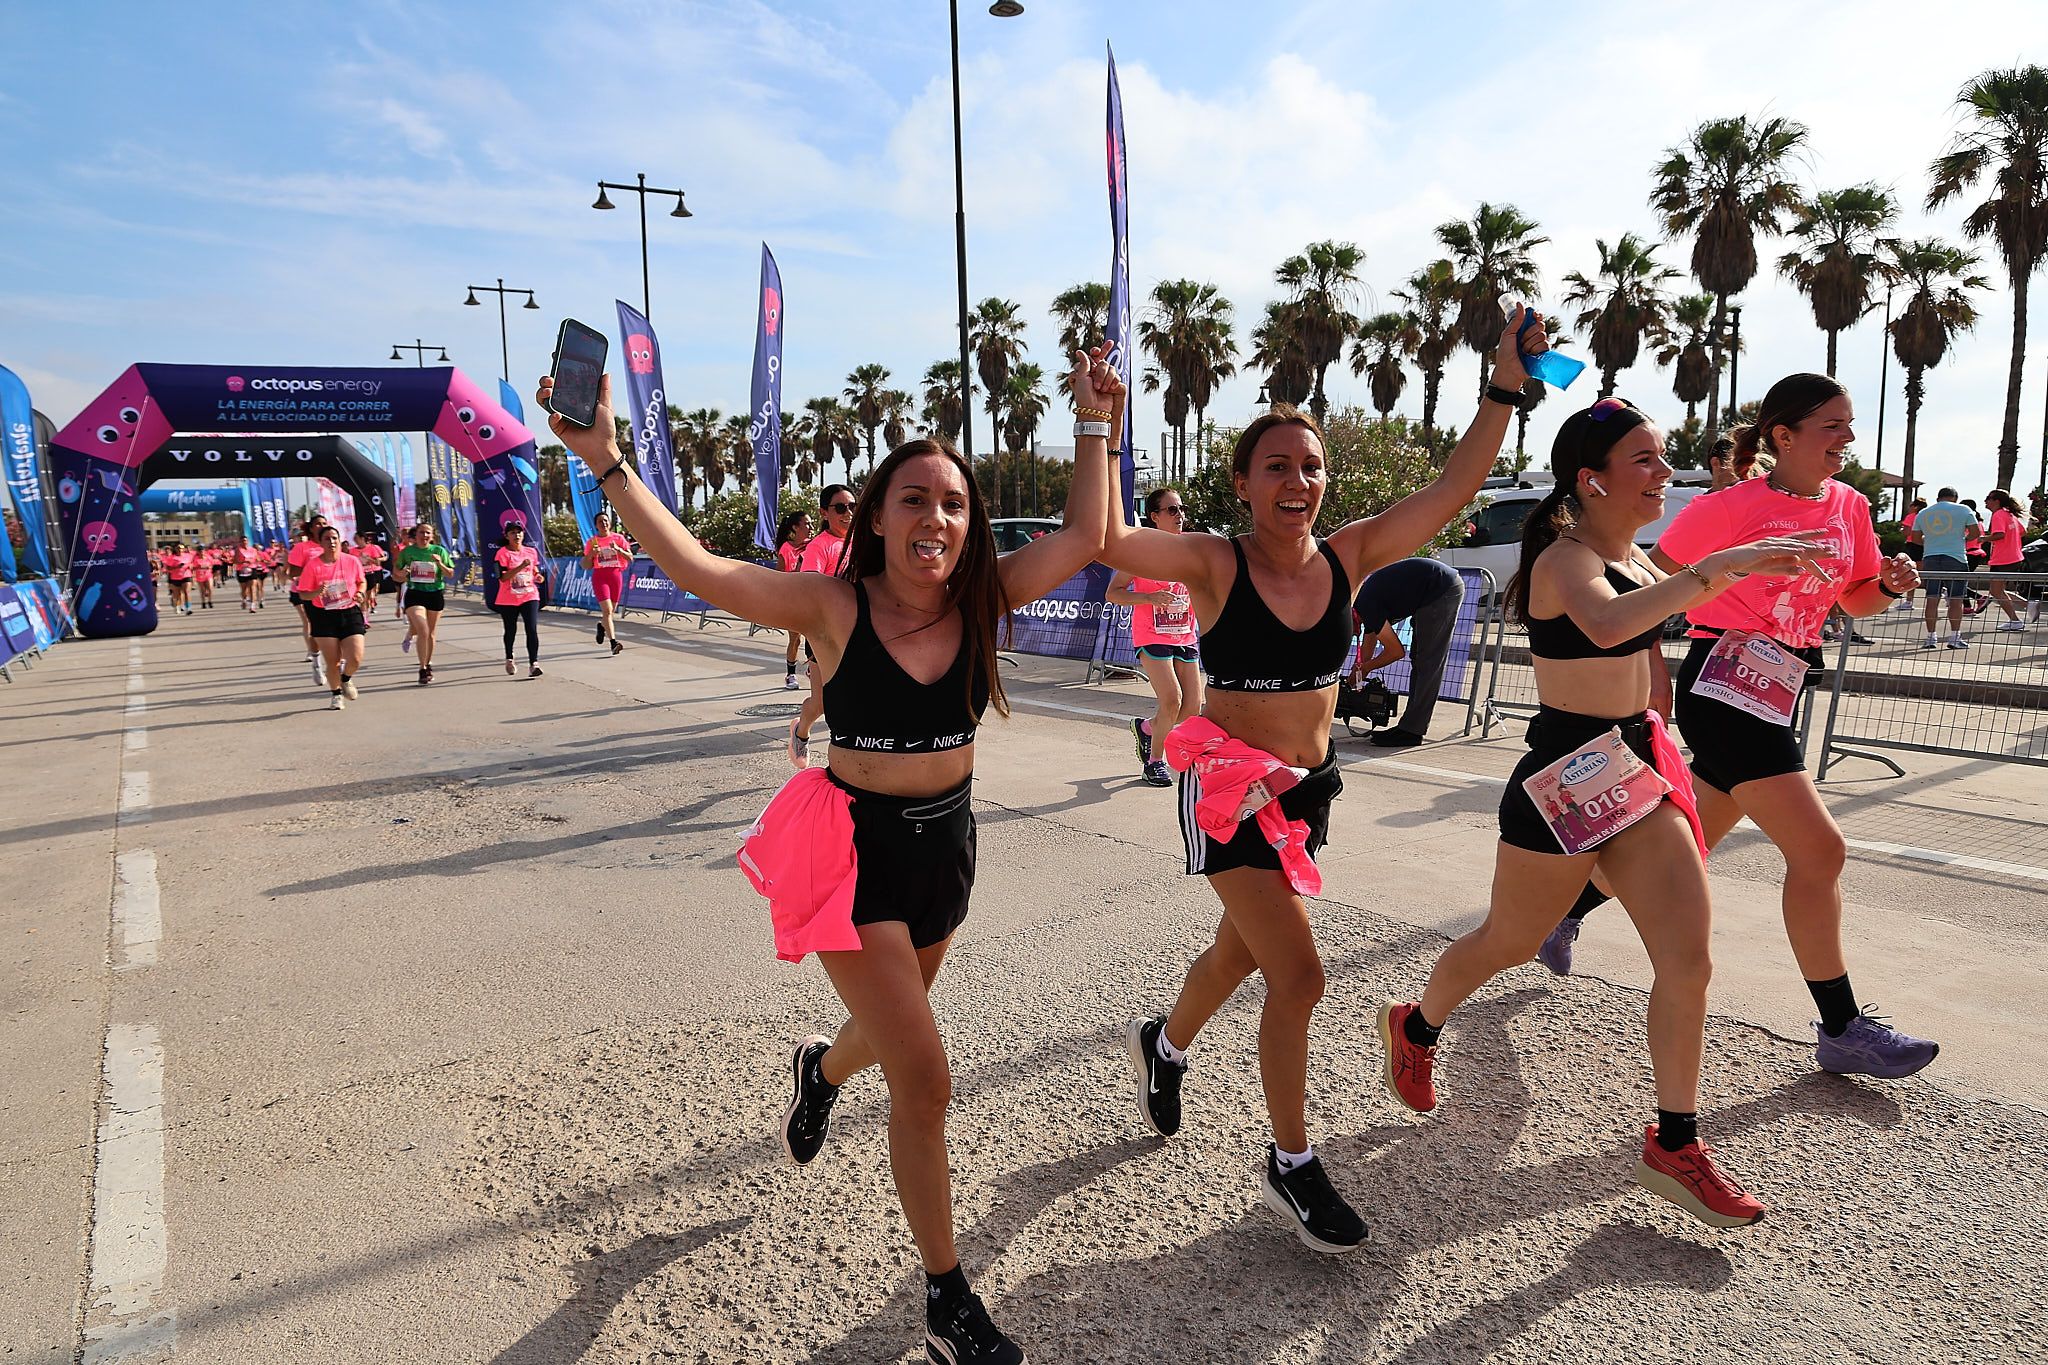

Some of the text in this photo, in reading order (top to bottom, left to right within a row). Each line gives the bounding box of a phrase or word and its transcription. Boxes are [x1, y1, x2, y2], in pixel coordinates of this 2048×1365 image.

[250, 377, 382, 396] octopus energy
[217, 398, 390, 411] LA ENERGÍA PARA CORRER
[216, 412, 393, 422] A LA VELOCIDAD DE LA LUZ
[169, 450, 313, 462] VOLVO
[1762, 520, 1799, 529] OYSHO
[635, 576, 660, 591] octopus
[1747, 641, 1782, 664] ASTURIANA
[1244, 671, 1337, 690] NIKE NIKE
[1736, 664, 1771, 690] 016
[1703, 685, 1734, 700] OYSHO
[855, 732, 965, 750] NIKE NIKE
[1563, 756, 1607, 784] ASTURIANA
[1536, 775, 1558, 791] SUMA
[1583, 784, 1631, 819] 016
[1605, 807, 1628, 824] 1158
[1577, 833, 1603, 850] CARRERA
[1601, 828, 1611, 837] DE
[1609, 824, 1619, 832] LA
[1617, 813, 1638, 827] MUJER
